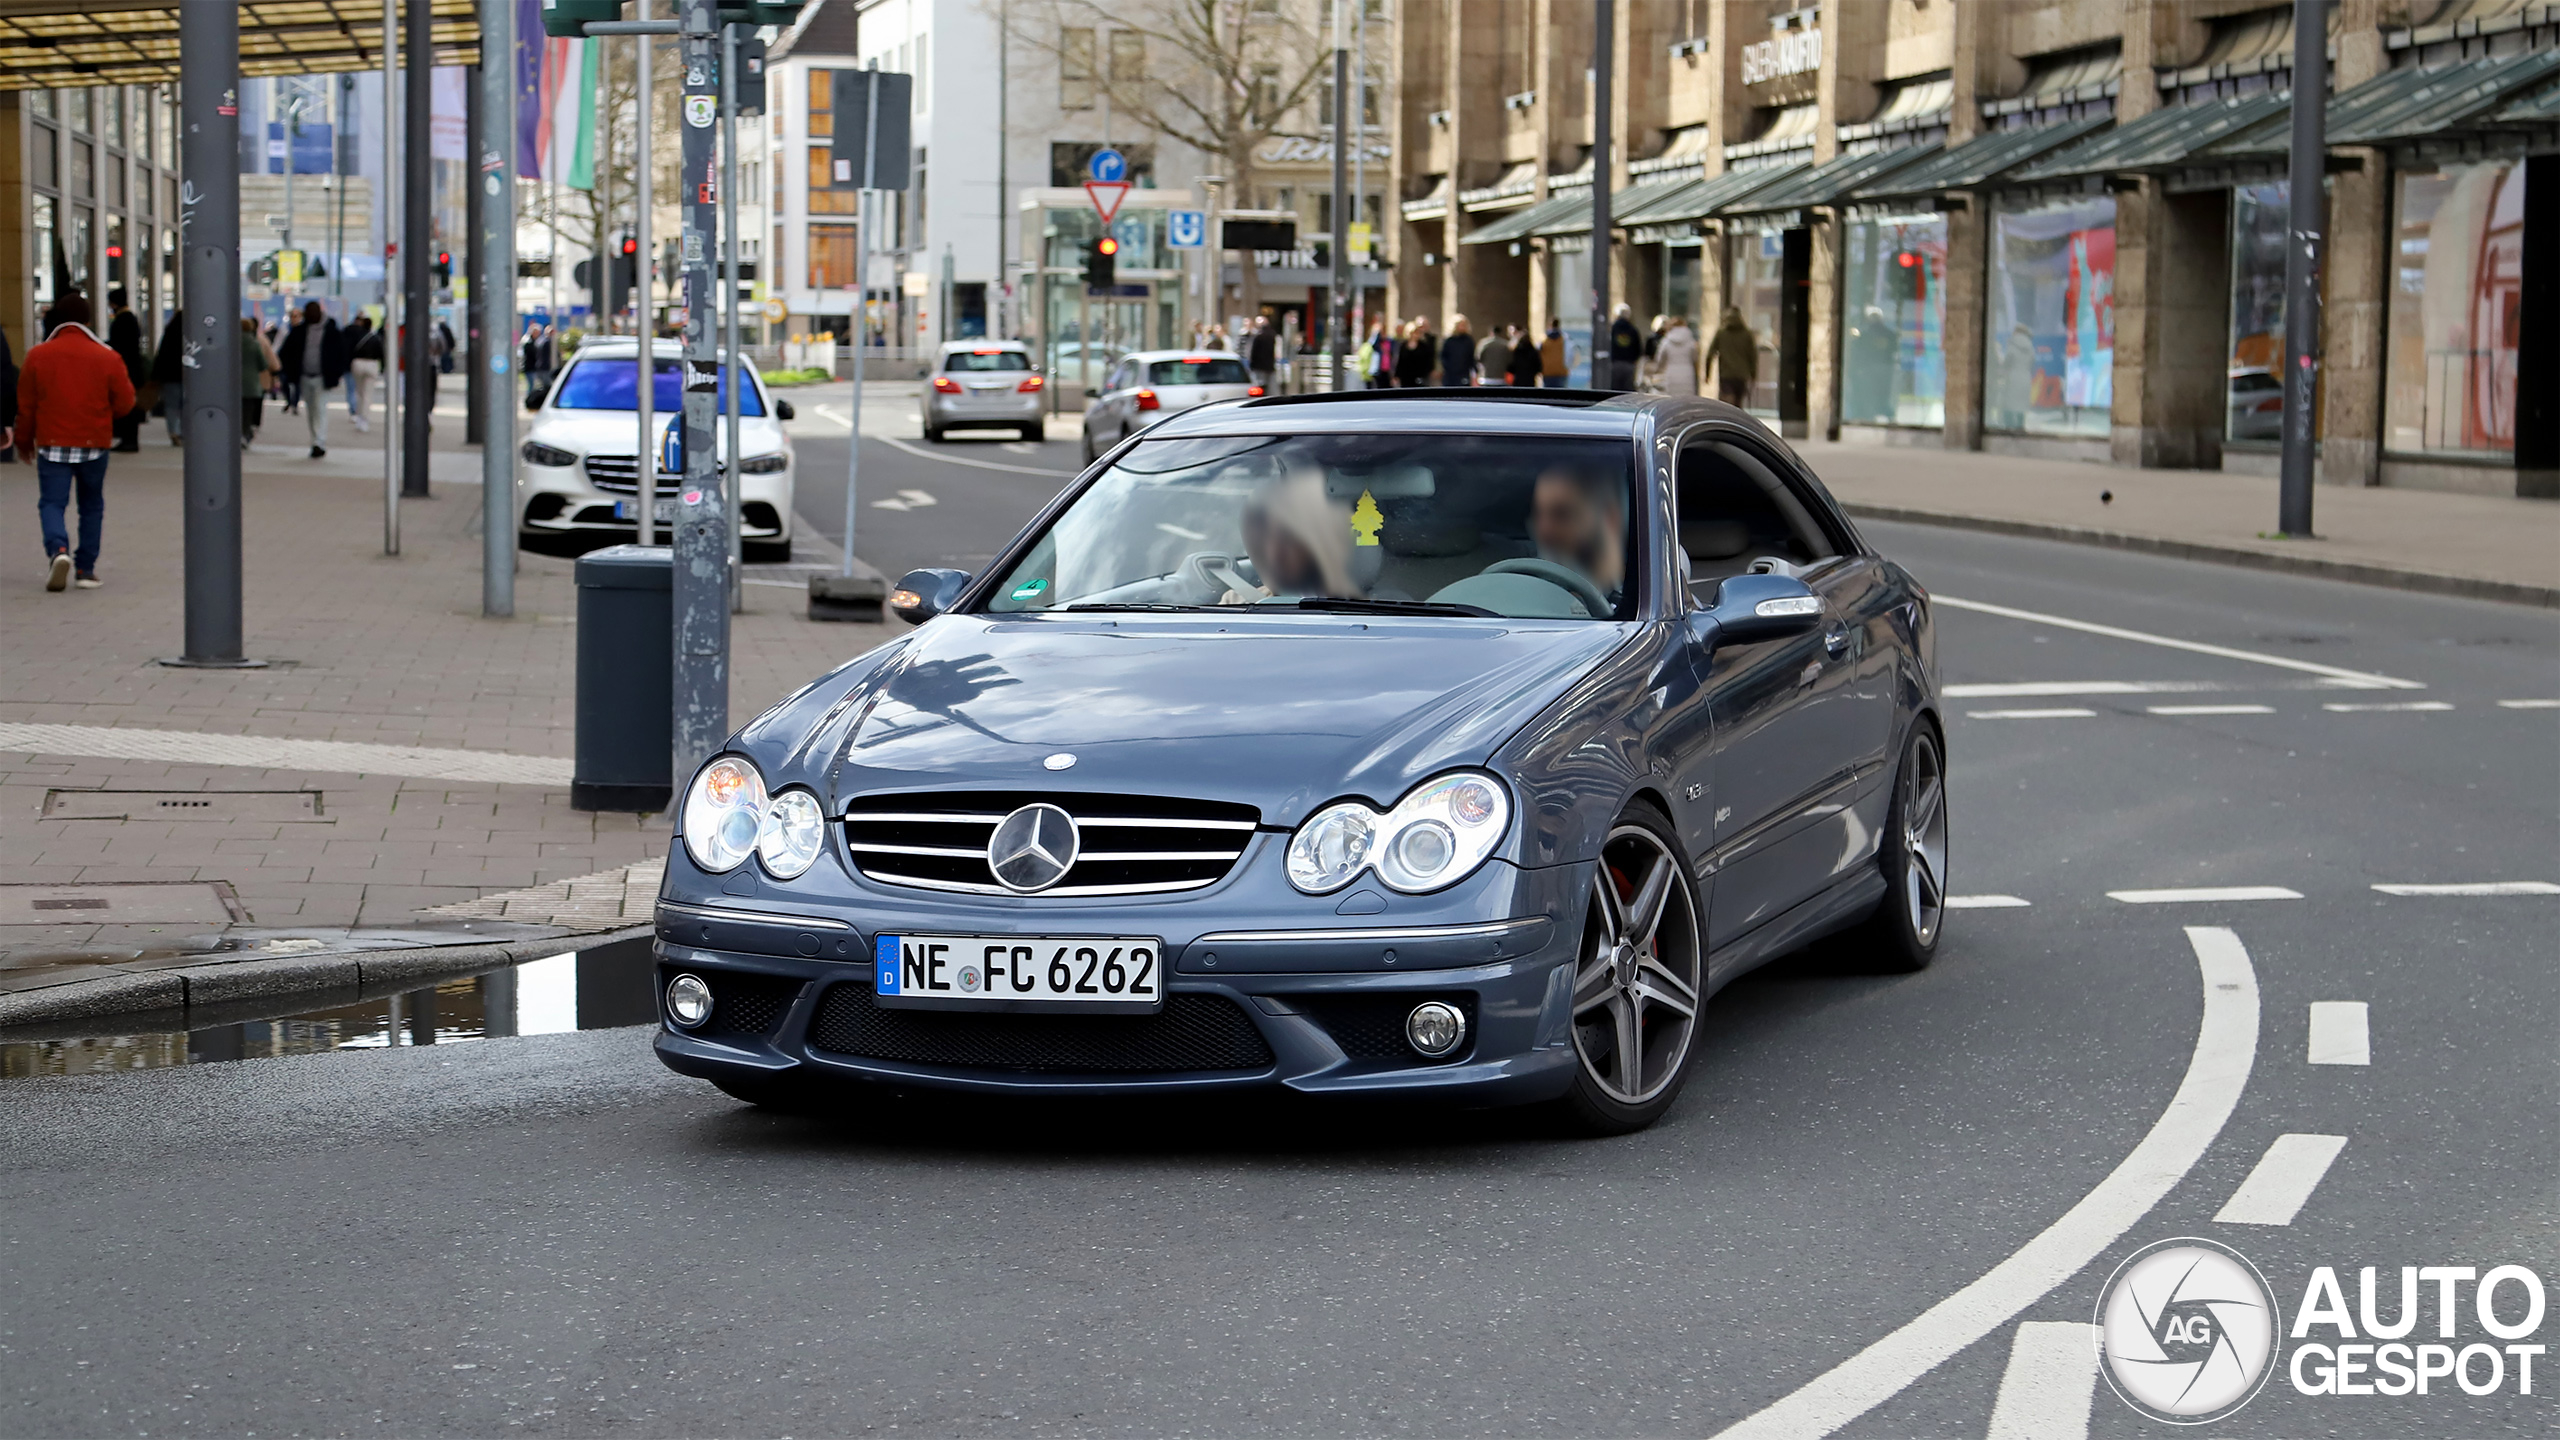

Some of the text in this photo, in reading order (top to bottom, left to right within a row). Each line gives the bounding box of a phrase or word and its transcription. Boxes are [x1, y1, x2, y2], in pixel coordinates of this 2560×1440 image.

[884, 943, 1153, 994] D NE FC 6262
